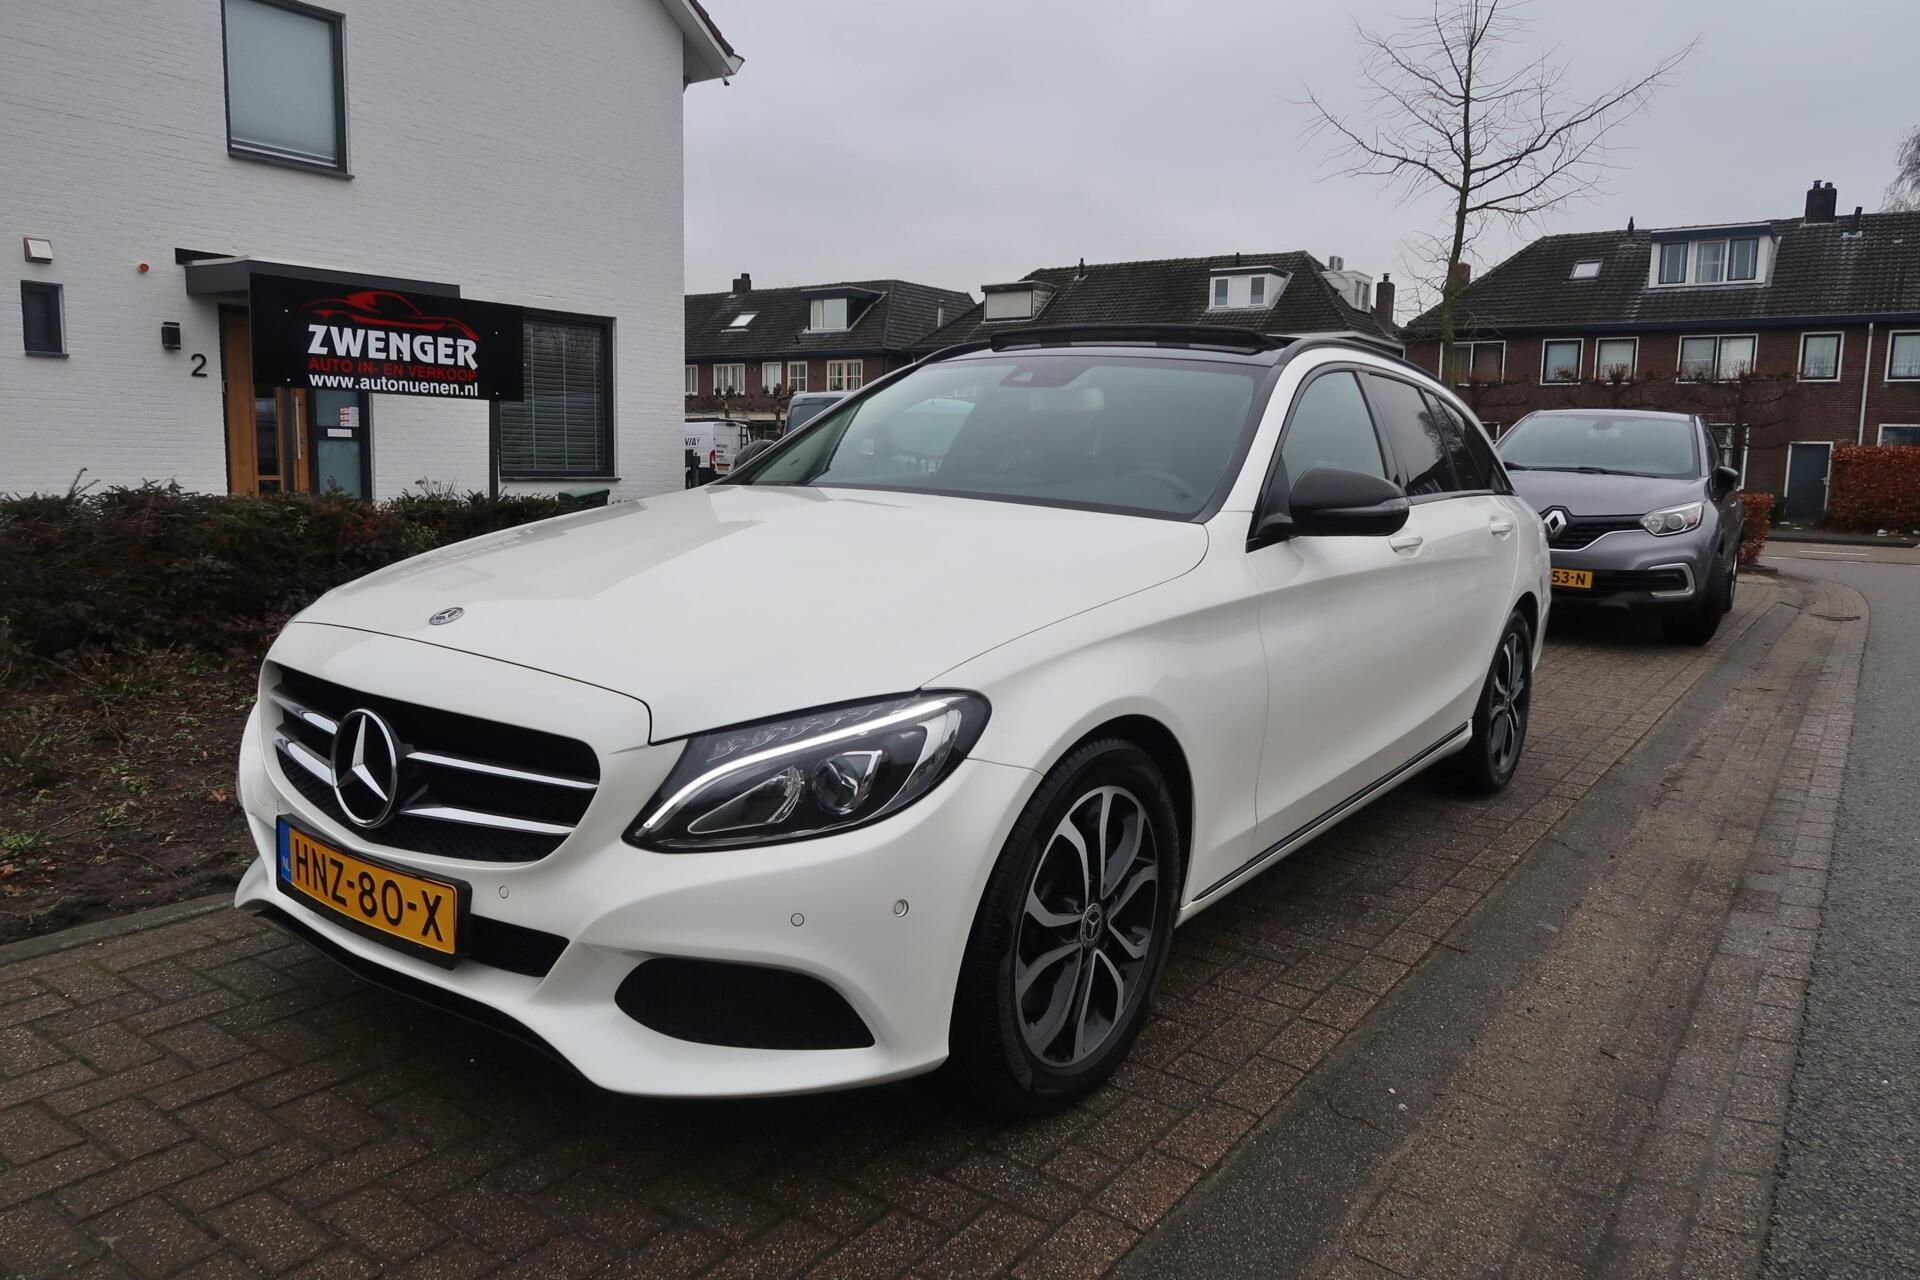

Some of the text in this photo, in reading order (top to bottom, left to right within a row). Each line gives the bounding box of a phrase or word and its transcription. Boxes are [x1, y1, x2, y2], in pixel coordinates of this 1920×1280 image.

[308, 324, 478, 370] ZWENGER
[191, 353, 208, 377] 2
[308, 357, 477, 381] AUTO IN- EN VERKOOP
[309, 374, 478, 396] www.autonuenen.nl
[295, 838, 443, 942] HNZ-80-X
